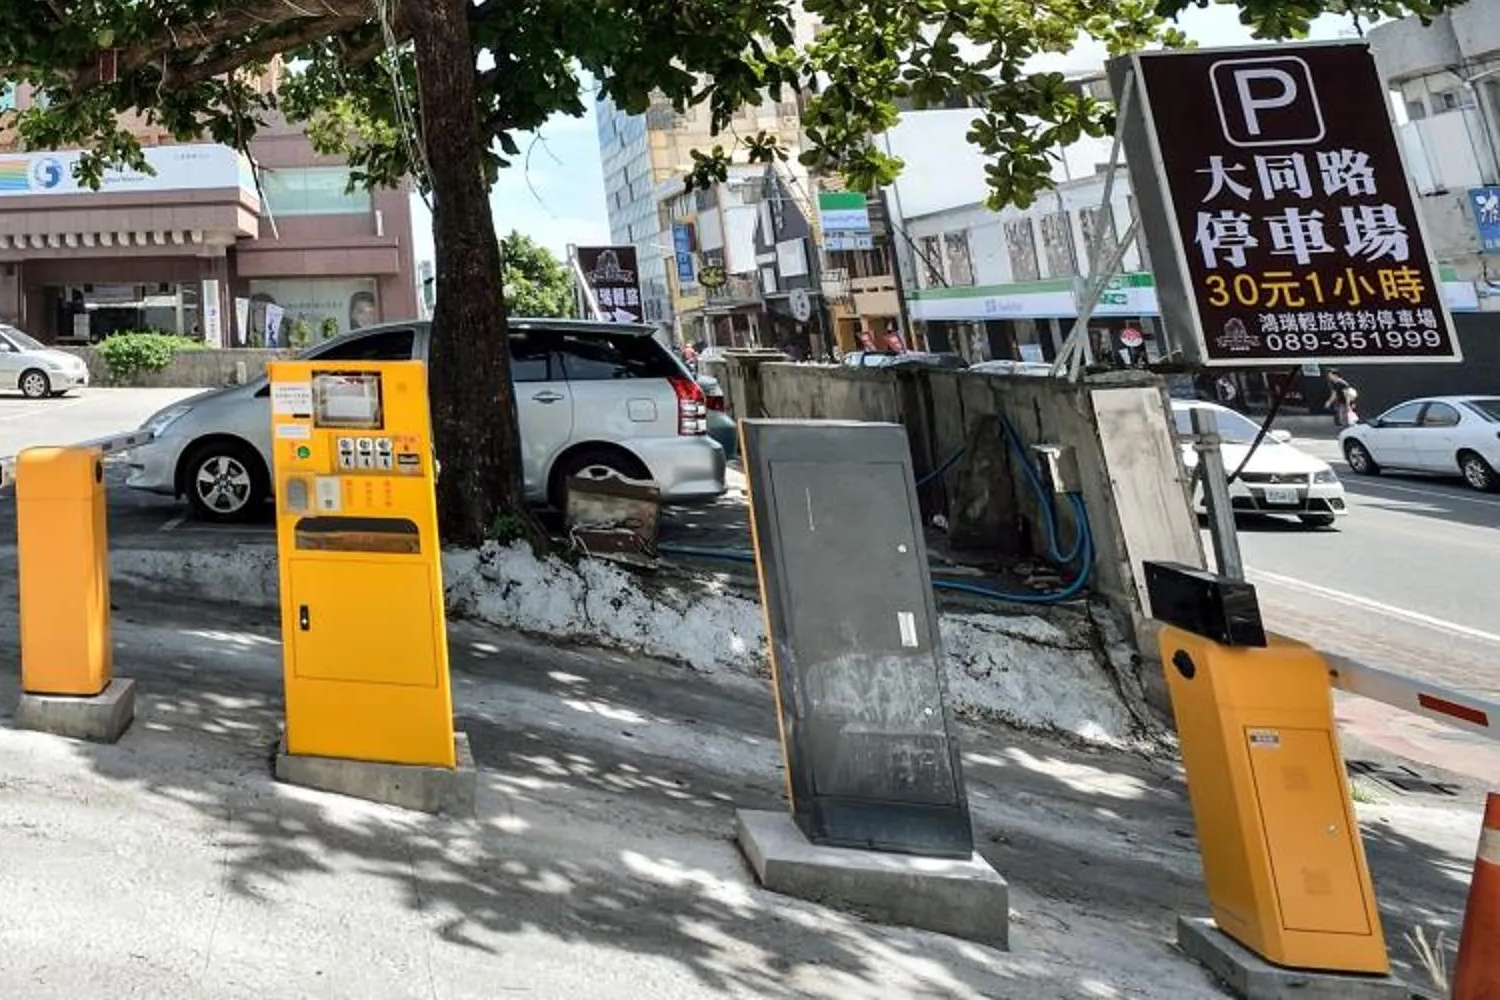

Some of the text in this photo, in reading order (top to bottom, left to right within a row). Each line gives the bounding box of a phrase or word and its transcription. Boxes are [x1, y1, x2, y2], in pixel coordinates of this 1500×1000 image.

[1233, 68, 1298, 136] P
[1194, 148, 1378, 202] 大同路
[1193, 203, 1411, 269] 停車場
[1204, 265, 1426, 308] 30元1小時
[1266, 330, 1443, 351] 089-351999
